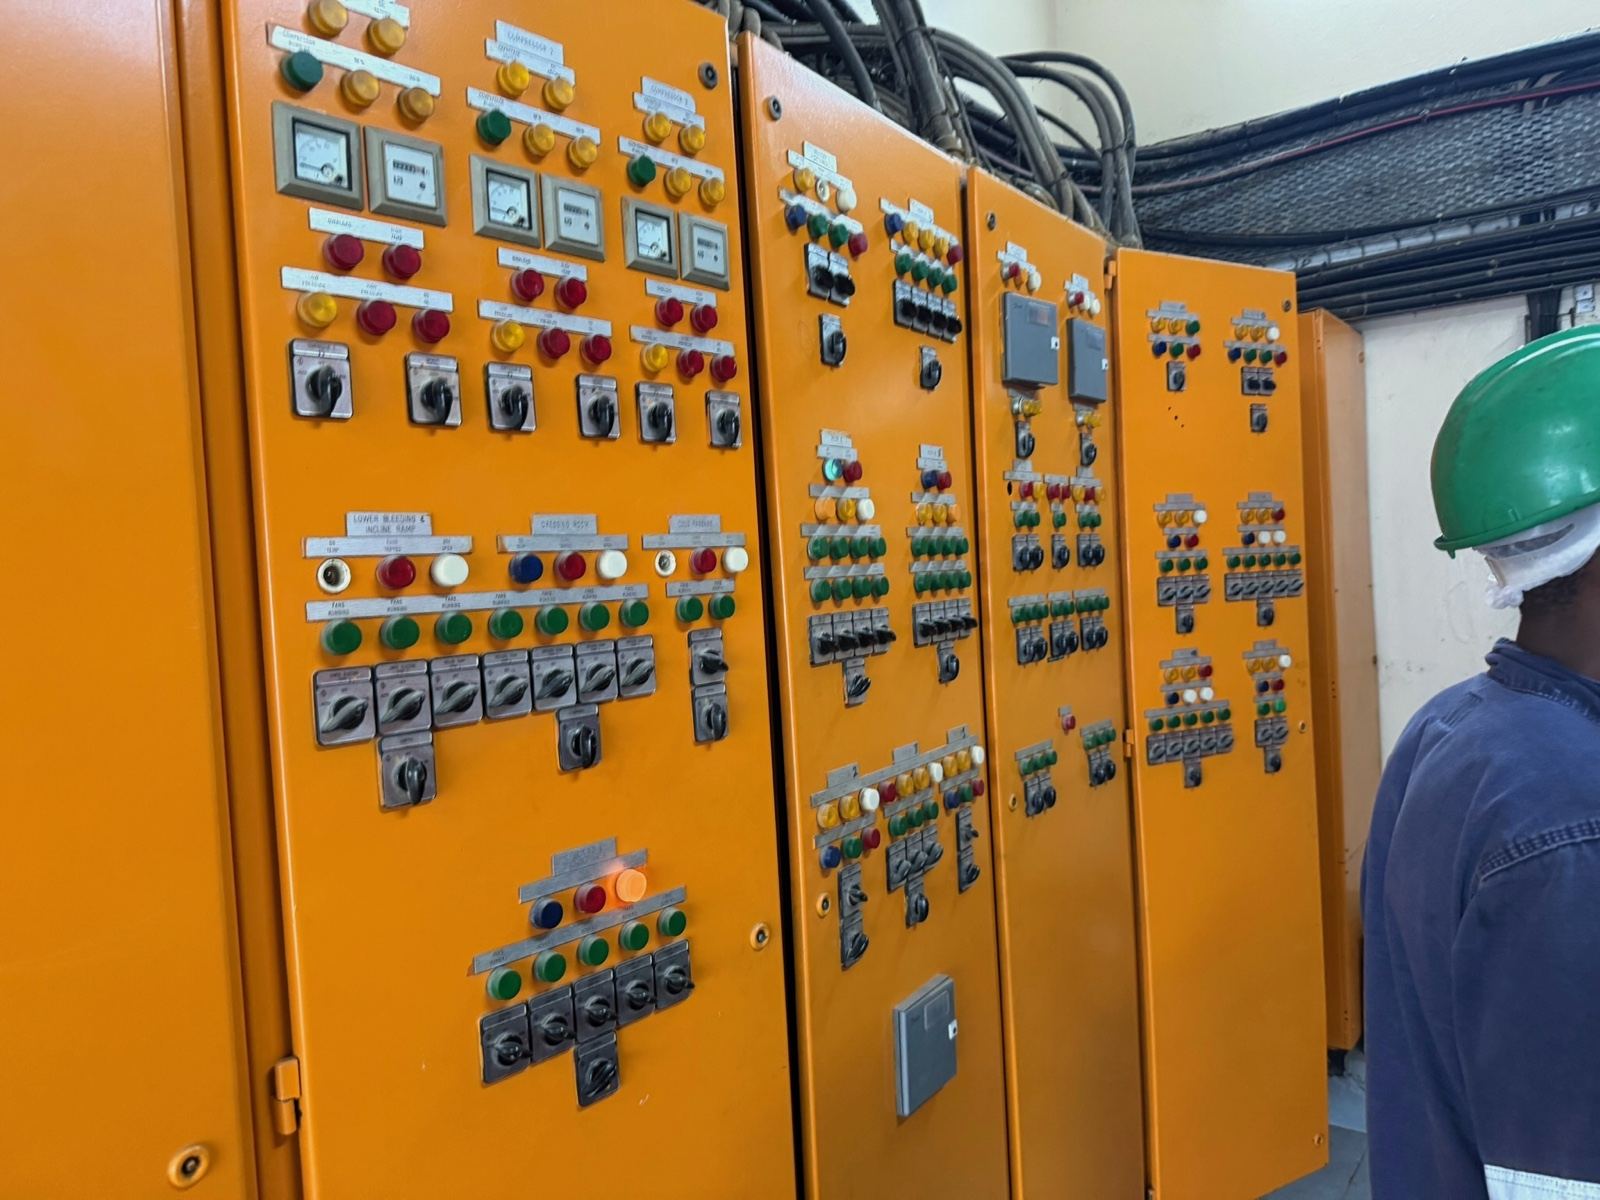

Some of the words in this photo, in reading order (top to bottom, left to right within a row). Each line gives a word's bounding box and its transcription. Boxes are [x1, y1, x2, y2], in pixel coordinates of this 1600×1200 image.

[353, 514, 379, 523] LOWER
[382, 514, 416, 523] BLEEDING
[365, 525, 392, 534] INCLINE
[396, 525, 416, 533] RAMP
